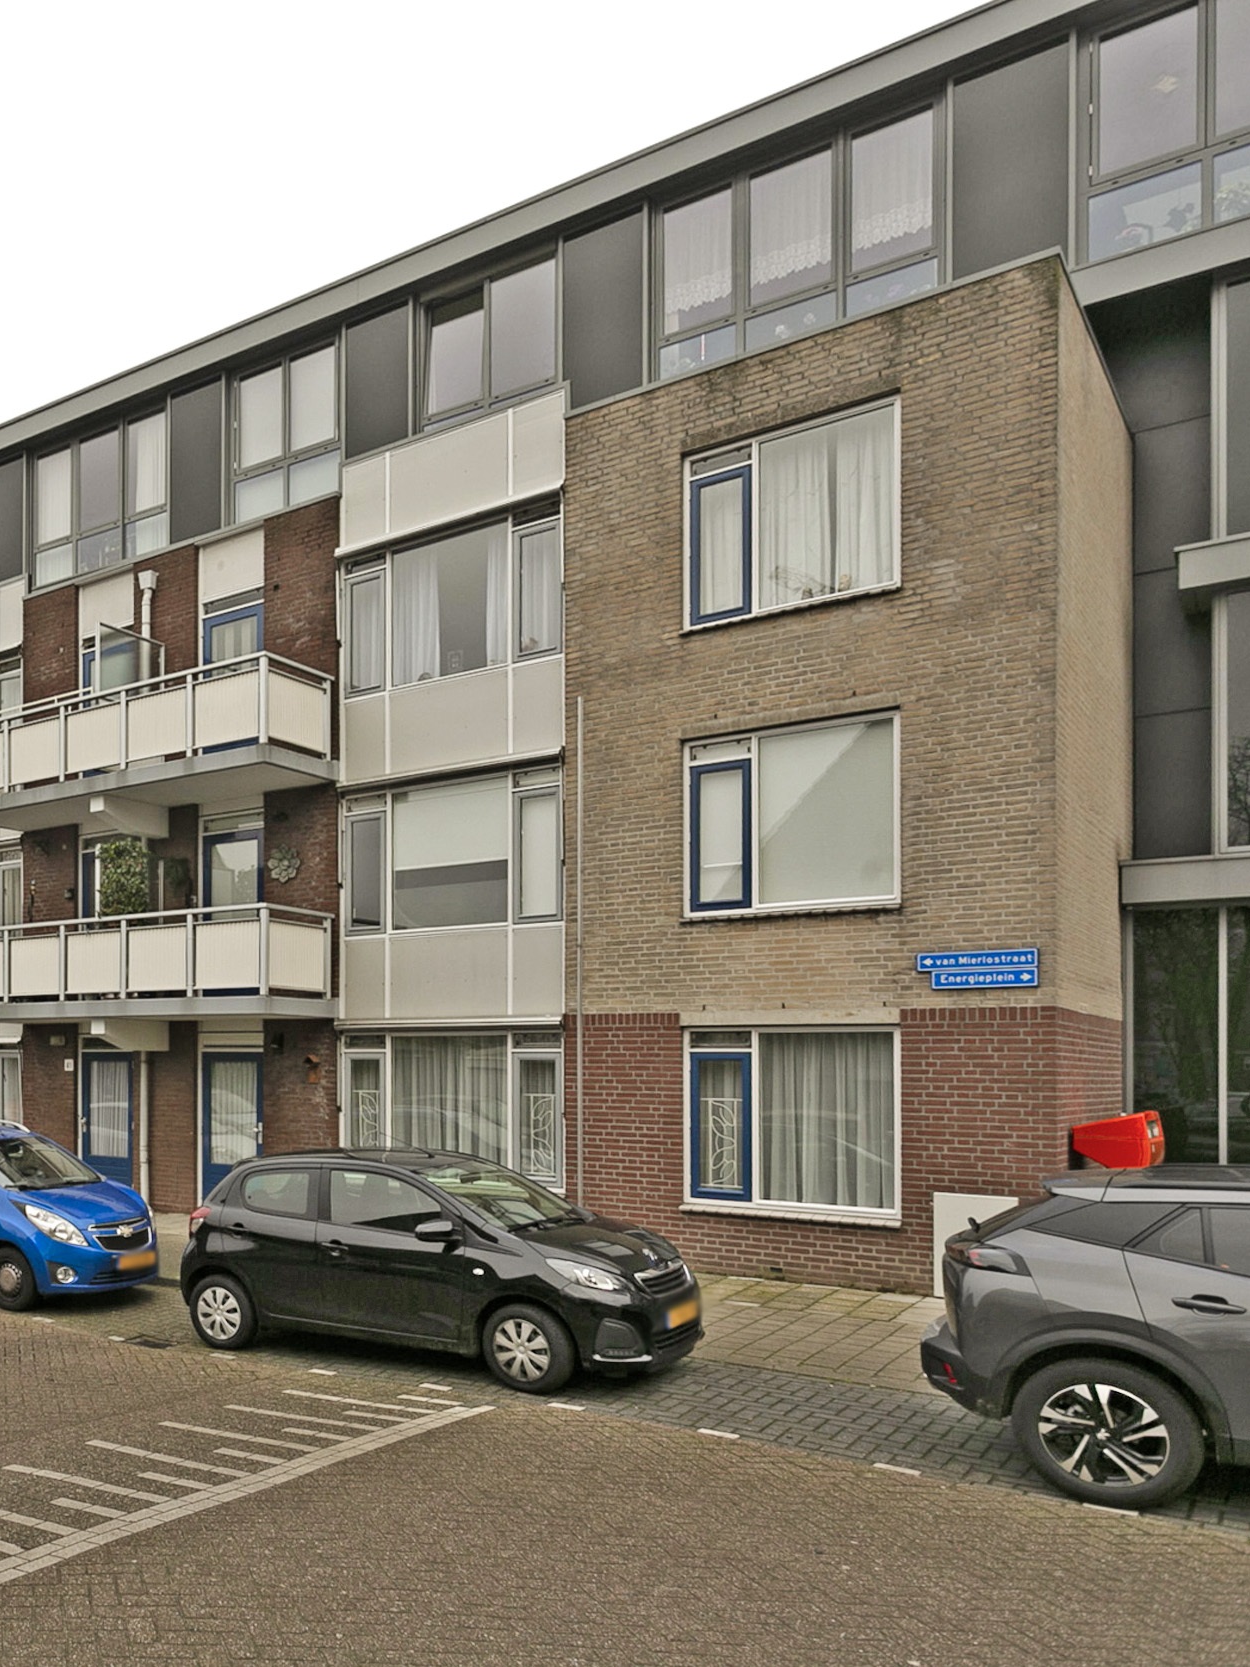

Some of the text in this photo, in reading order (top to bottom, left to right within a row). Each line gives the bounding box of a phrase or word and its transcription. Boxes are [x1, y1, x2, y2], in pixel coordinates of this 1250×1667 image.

[935, 953, 1033, 966] van Mierlostraat
[940, 972, 1015, 985] Energieplein
